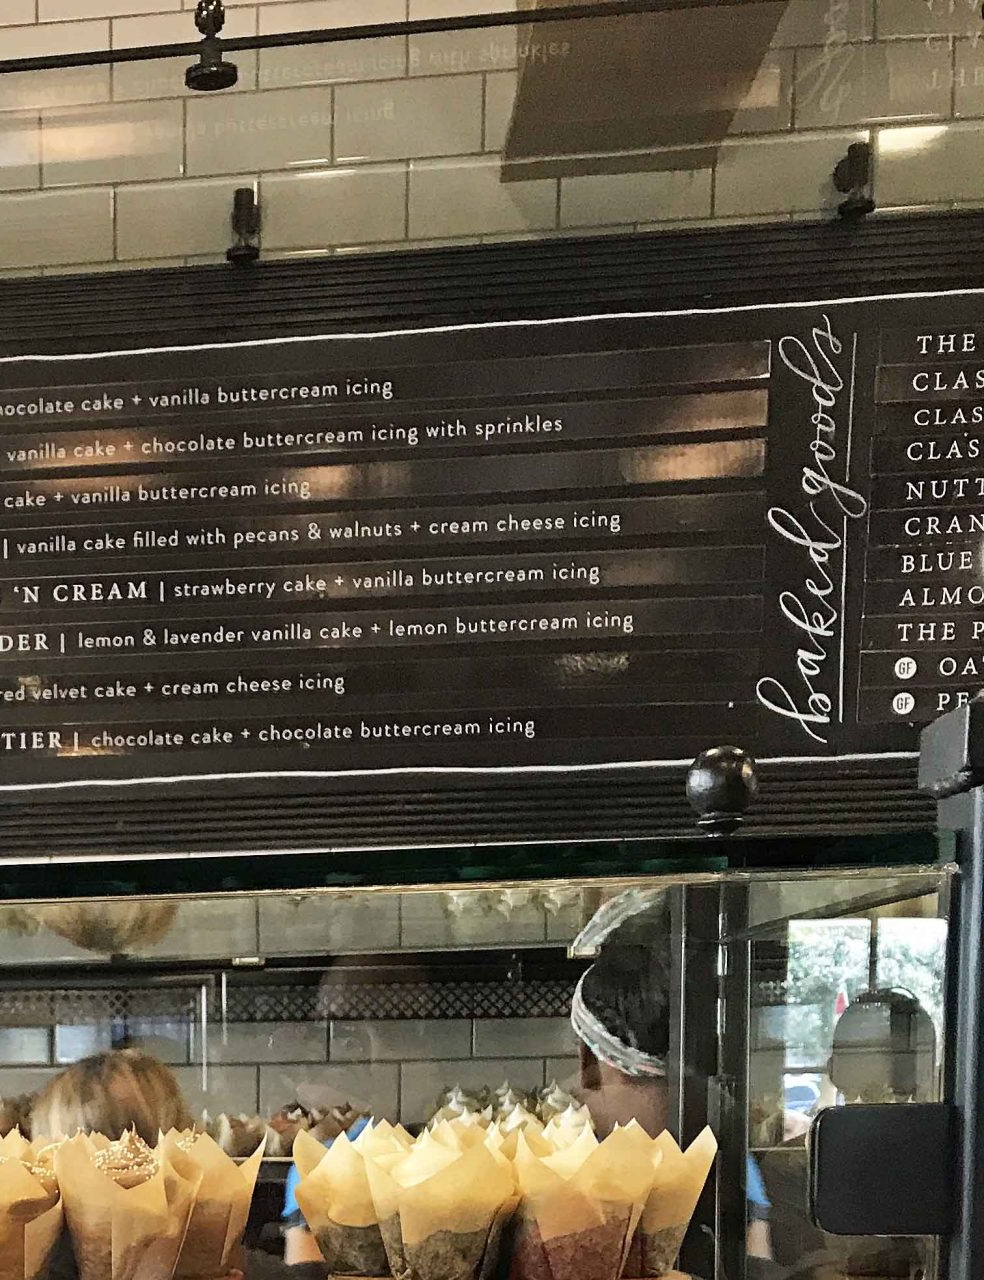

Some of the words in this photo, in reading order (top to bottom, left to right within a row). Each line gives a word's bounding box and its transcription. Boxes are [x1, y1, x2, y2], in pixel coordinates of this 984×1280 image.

[917, 334, 976, 354] THE
[81, 393, 123, 411] cake
[149, 389, 210, 409] vanilla
[218, 384, 338, 403] buttercream
[346, 378, 393, 400] icing
[779, 314, 867, 518] goods
[914, 407, 983, 426] CLAS
[6, 444, 66, 463] vanilla
[73, 442, 116, 458] cake
[141, 435, 235, 454] chocolate
[243, 430, 364, 449] buttercream
[372, 424, 418, 445] icing
[426, 419, 466, 438] with
[475, 415, 562, 440] sprinkles
[907, 439, 980, 461] CLAS
[2, 492, 46, 508] cake
[71, 488, 130, 506] vanilla
[138, 481, 257, 501] buttercream
[265, 479, 311, 500] icing
[17, 535, 76, 553] vanilla
[83, 533, 125, 550] cake
[133, 530, 178, 548] filled
[186, 528, 225, 546] with
[234, 529, 299, 549] pecans
[308, 522, 321, 541] &
[329, 520, 402, 539] walnuts
[429, 521, 488, 534] cream
[497, 514, 565, 532] cheese
[574, 510, 620, 533] icing
[904, 514, 984, 536] CRAN
[901, 551, 973, 573] BLUE
[53, 581, 147, 602] CREAM
[174, 578, 276, 598] strawberry
[283, 574, 327, 593] cake
[353, 570, 413, 589] vanilla
[423, 568, 543, 586] buttercream
[553, 562, 600, 585] icing
[899, 586, 984, 607] ALMO
[78, 632, 134, 648] lemon
[143, 629, 156, 646] &
[164, 626, 244, 645] lavender
[251, 623, 311, 642] vanilla
[320, 622, 362, 640] cake
[390, 620, 447, 636] lemon
[456, 617, 577, 635] buttercream
[587, 611, 633, 634] icing
[756, 501, 842, 743] baked
[898, 622, 956, 642] THE
[939, 656, 984, 676] OA
[31, 683, 88, 700] velvet
[94, 681, 136, 697] cake
[162, 682, 218, 695] cream
[226, 675, 292, 693] cheese
[300, 673, 345, 695] icing
[91, 729, 184, 748] chocolate
[191, 727, 233, 744] cake
[258, 722, 352, 742] chocolate
[361, 721, 480, 738] buttercream
[489, 717, 535, 738] icing
